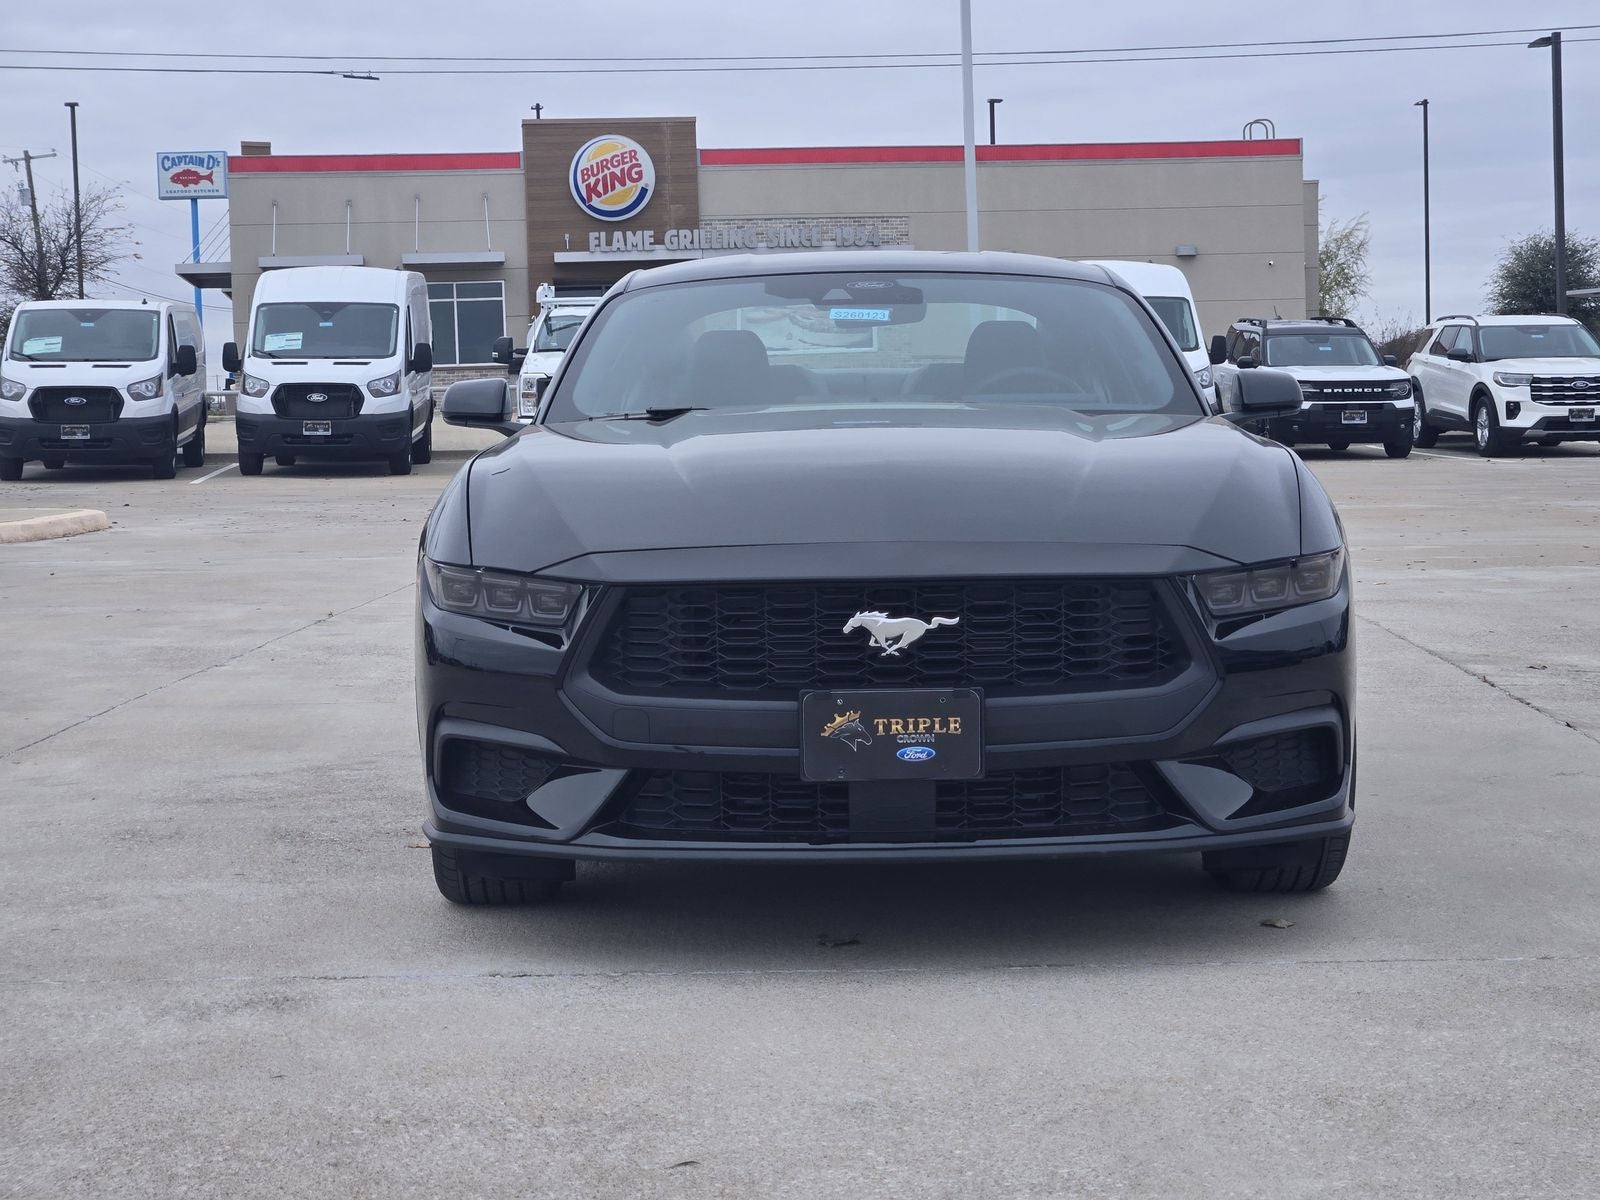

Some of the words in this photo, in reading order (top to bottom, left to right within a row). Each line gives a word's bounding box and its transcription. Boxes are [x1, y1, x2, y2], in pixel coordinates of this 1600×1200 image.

[161, 155, 205, 172] CAPTAIN
[206, 154, 221, 170] D's
[580, 149, 639, 184] BURGER
[584, 162, 643, 205] KING
[588, 229, 655, 252] FLAME
[664, 227, 759, 250] GRILLING
[766, 225, 822, 248] SINCE
[834, 225, 881, 248] 1954
[834, 311, 886, 320] S260123
[874, 717, 962, 736] TRIPLE
[896, 734, 936, 744] CROWN
[902, 748, 929, 760] Ford
